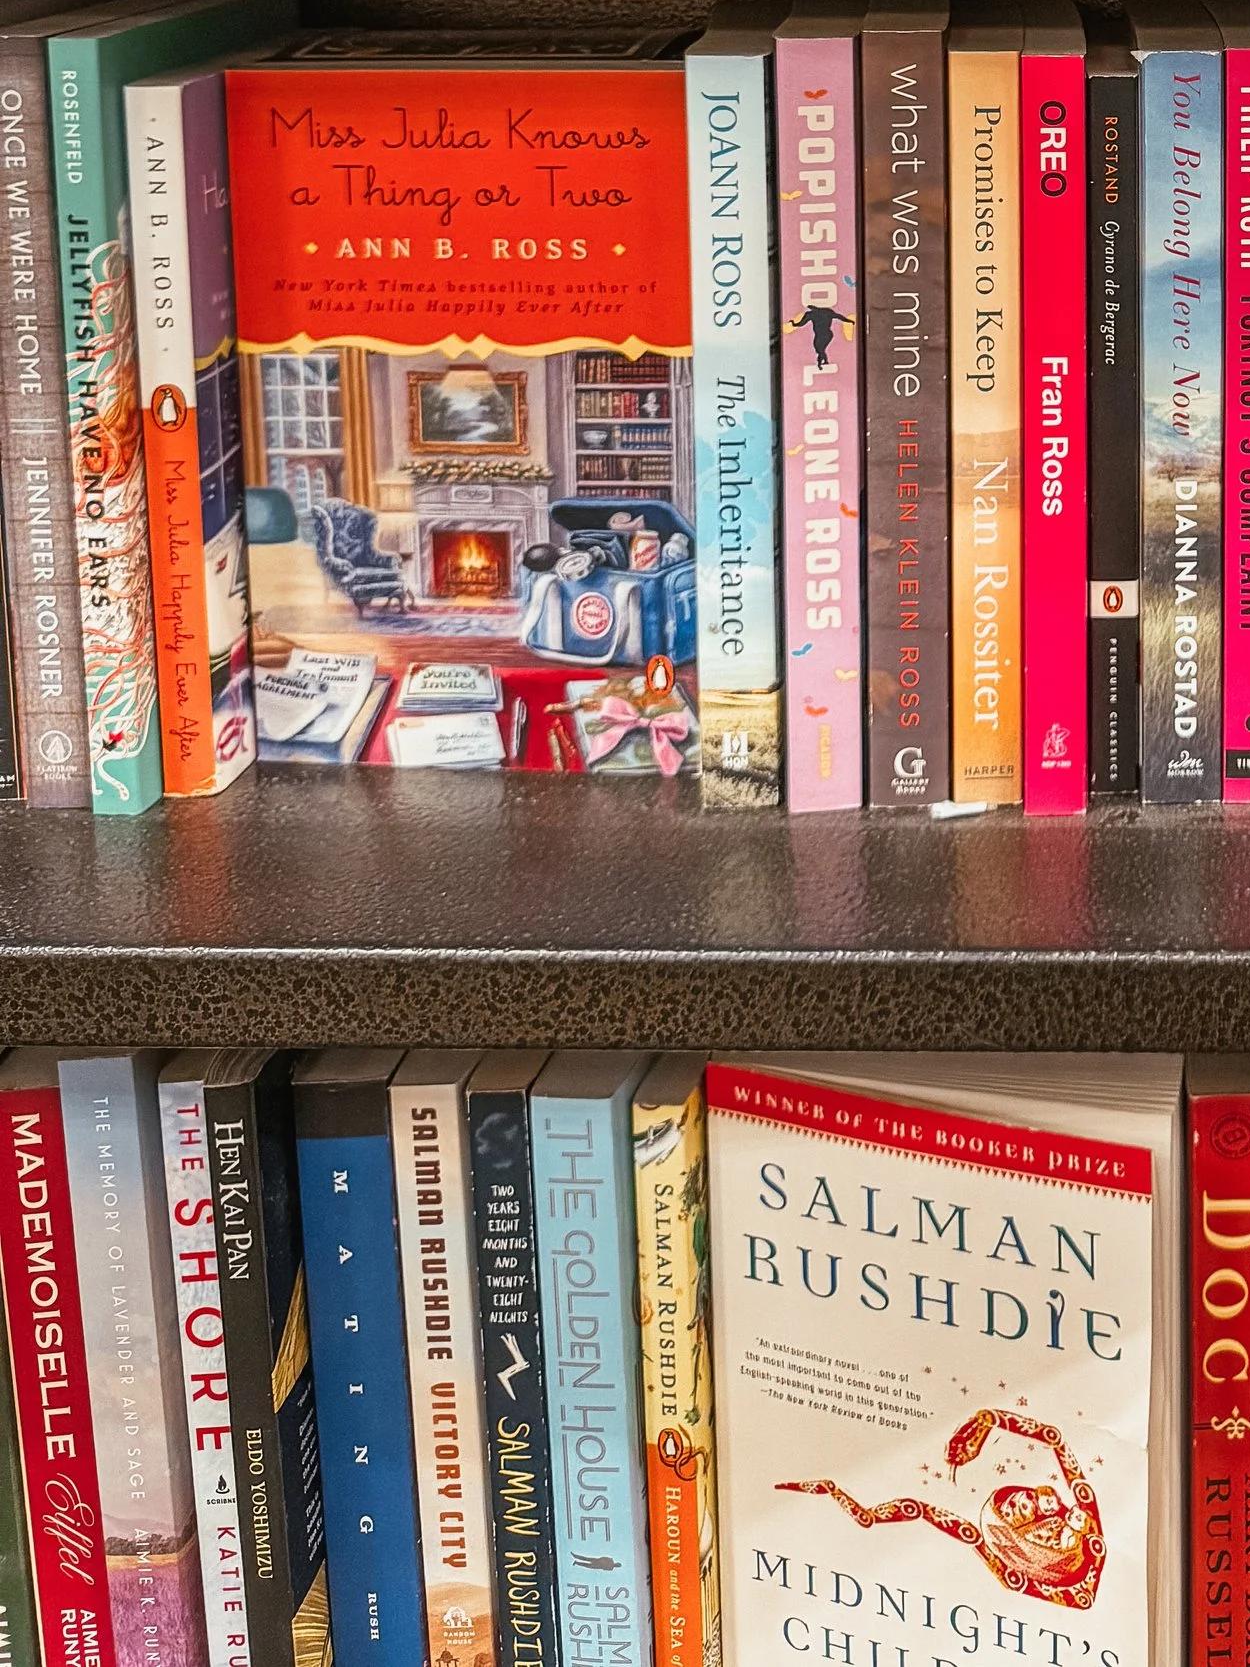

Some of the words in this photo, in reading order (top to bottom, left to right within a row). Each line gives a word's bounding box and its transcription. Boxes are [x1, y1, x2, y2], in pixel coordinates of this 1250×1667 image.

[271, 108, 365, 149] Miss
[382, 108, 490, 149] Julia
[508, 109, 650, 149] Knows
[890, 64, 927, 174] what
[974, 106, 1003, 252] Promises
[1104, 116, 1118, 205] ROSTAND
[291, 186, 319, 205] a
[334, 165, 461, 226] Thing
[476, 185, 520, 206] or
[536, 166, 632, 206] Two
[335, 238, 411, 259] ANN
[435, 238, 469, 259] B.
[493, 239, 587, 260] ROSS
[892, 190, 919, 274] was
[1099, 221, 1120, 276] Cyrano
[976, 265, 1002, 295] to
[1105, 280, 1115, 296] de
[894, 292, 928, 397] mine
[967, 309, 1003, 392] Keep
[1100, 302, 1120, 365] Bergerac
[899, 419, 919, 521] HELEN
[973, 459, 1009, 547] Nan
[899, 540, 919, 630] KLEIN
[974, 565, 1010, 729] Rossiter
[899, 648, 919, 727] ROSS
[965, 765, 1014, 776] HARPER
[488, 1202, 519, 1214] YEARS
[491, 1186, 514, 1196] TWO
[760, 1163, 1100, 1280] SALMAN
[482, 1237, 527, 1250] MONTHS
[489, 1219, 519, 1232] EIGHT
[486, 1275, 528, 1287] TWENTY-
[494, 1256, 517, 1268] AND
[490, 1311, 528, 1323] NIGHTS
[493, 1293, 522, 1306] EIGHT
[744, 1234, 1122, 1360] RUSHDIE
[246, 1428, 264, 1476] ELDO
[431, 1382, 462, 1498] VICTORY
[251, 1481, 273, 1579] YOSHIMIZU
[439, 1512, 466, 1568] CITY
